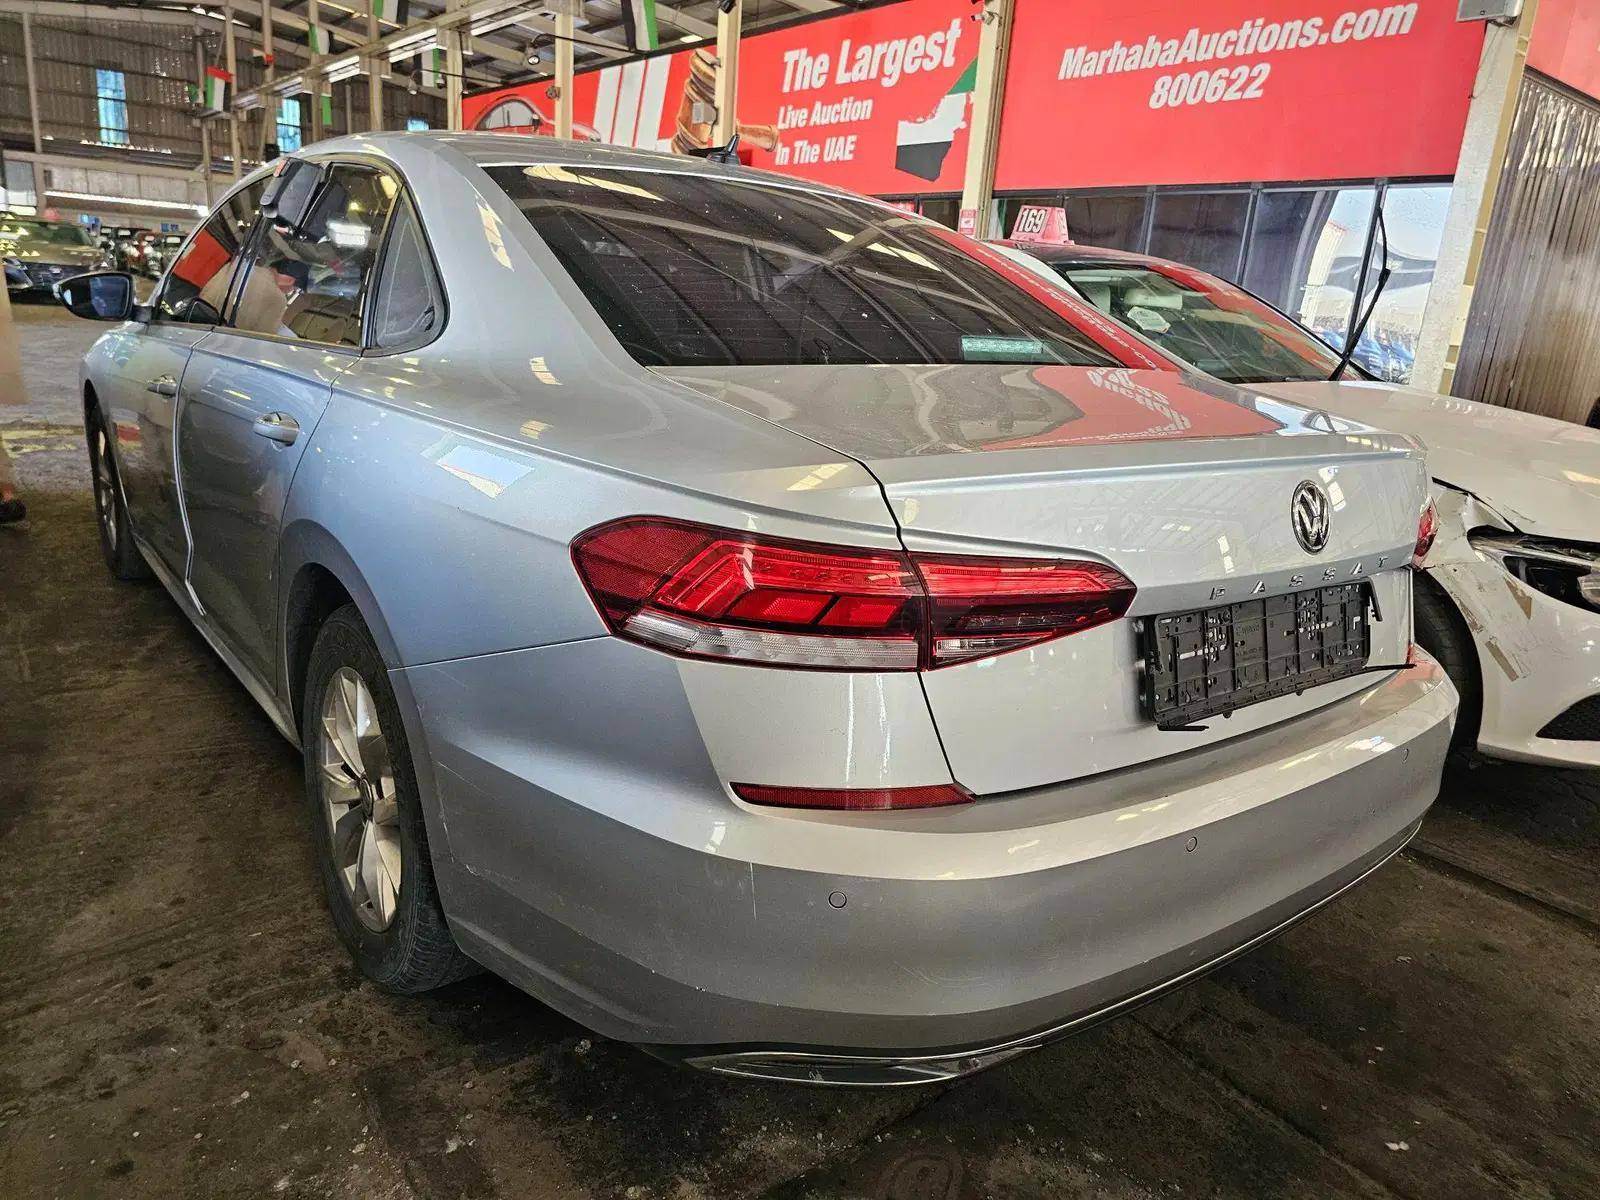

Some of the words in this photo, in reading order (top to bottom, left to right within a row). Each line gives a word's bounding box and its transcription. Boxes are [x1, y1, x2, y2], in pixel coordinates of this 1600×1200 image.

[782, 47, 830, 94] The
[834, 18, 963, 88] Largest
[1058, 2, 1417, 80] MarhabaAuctions.com
[1149, 63, 1271, 109] 800622
[777, 103, 808, 130] Live
[810, 96, 874, 126] Auction
[774, 143, 789, 166] In
[792, 139, 822, 164] The
[824, 135, 857, 163] UAE
[1018, 208, 1045, 234] 169
[1209, 556, 1389, 600] PASSAT
